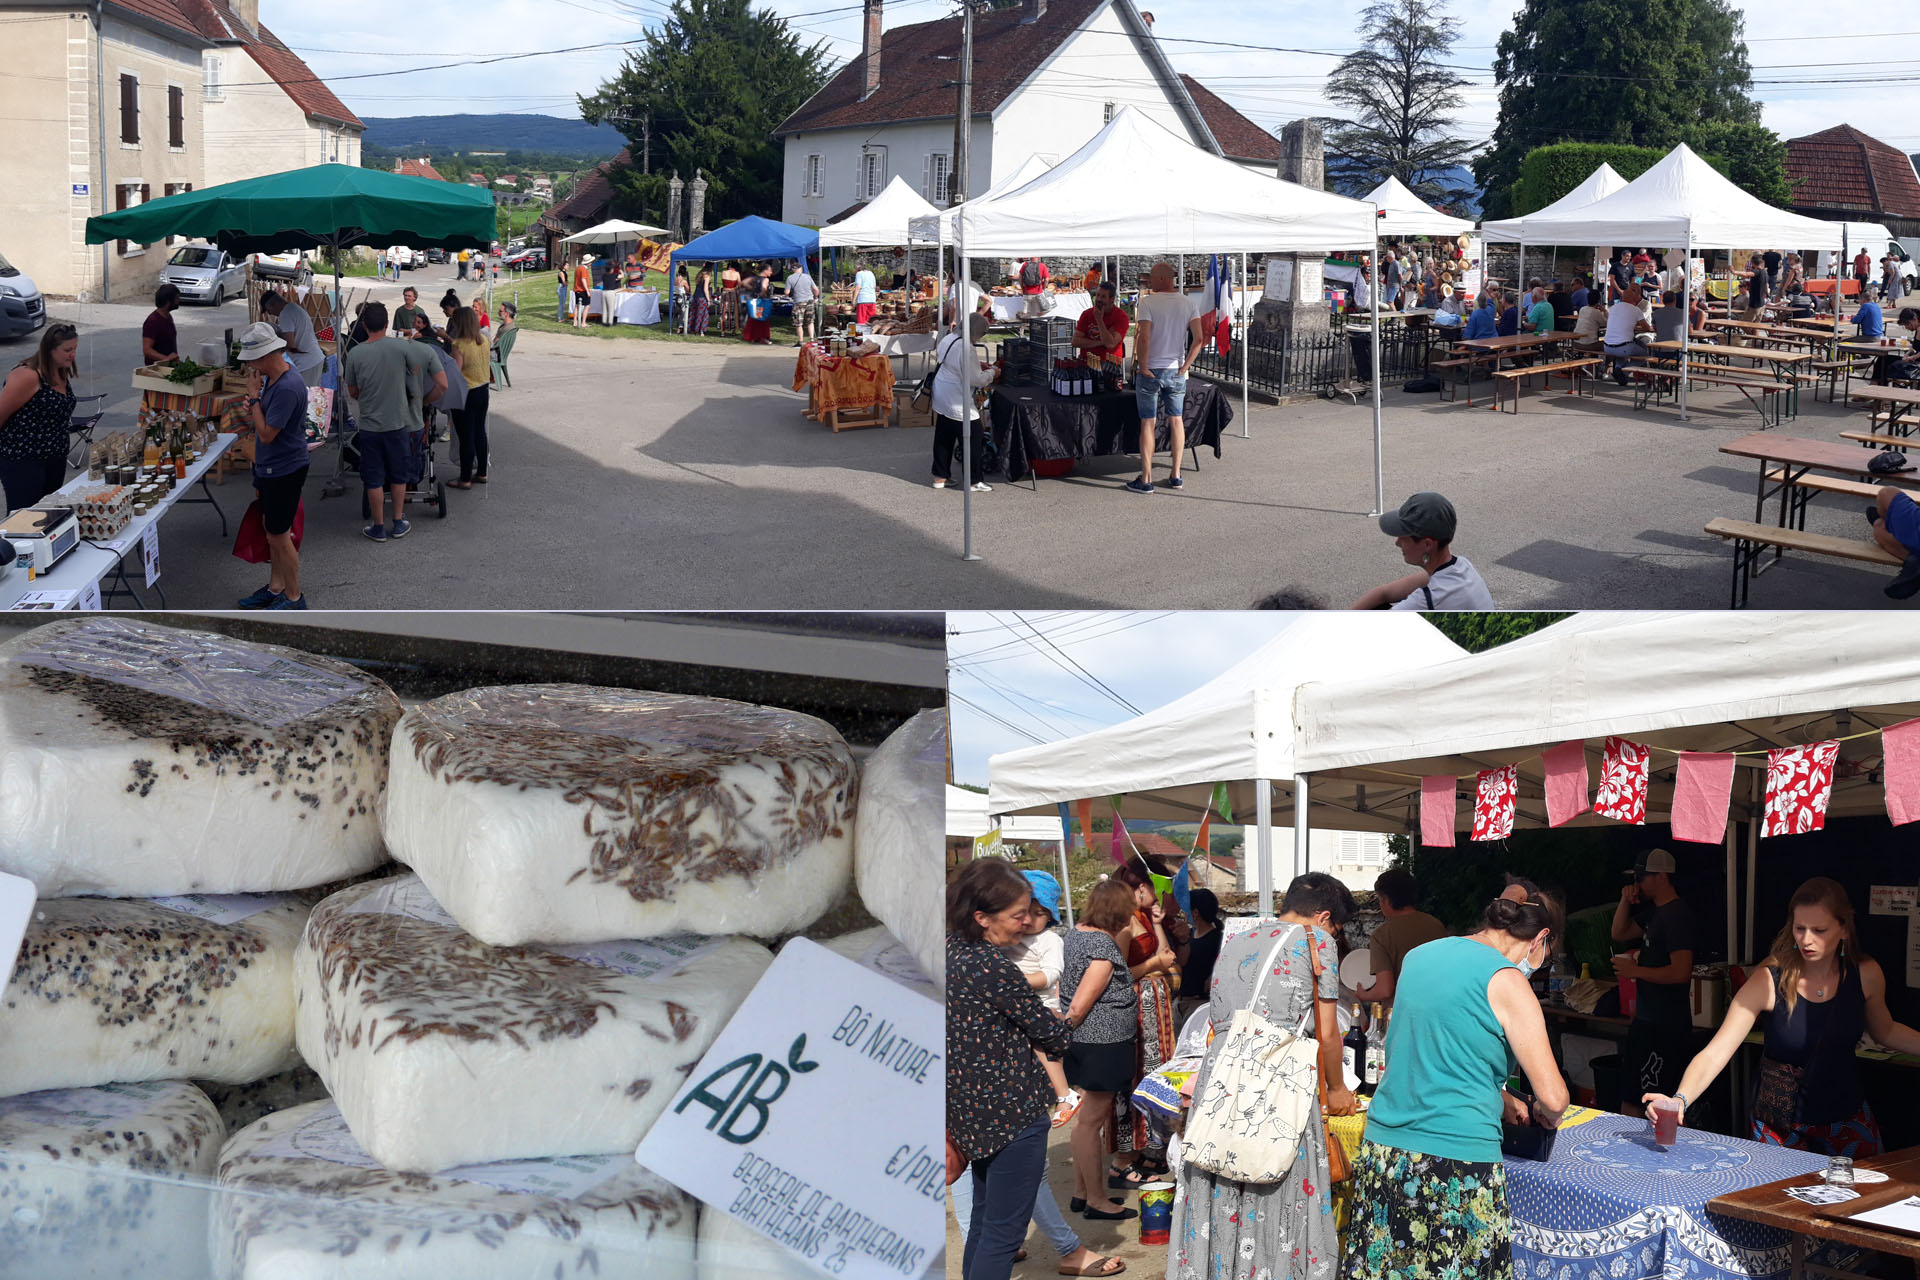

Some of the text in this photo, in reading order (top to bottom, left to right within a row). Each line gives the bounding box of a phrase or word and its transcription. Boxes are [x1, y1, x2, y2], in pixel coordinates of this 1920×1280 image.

[860, 1019, 941, 1085] NATURE
[673, 1052, 791, 1145] AB
[732, 1151, 925, 1276] BERGERIE DE BARTHERANS
[884, 1144, 946, 1206] €/PIEC
[728, 1186, 856, 1274] BARTHERANS 25
